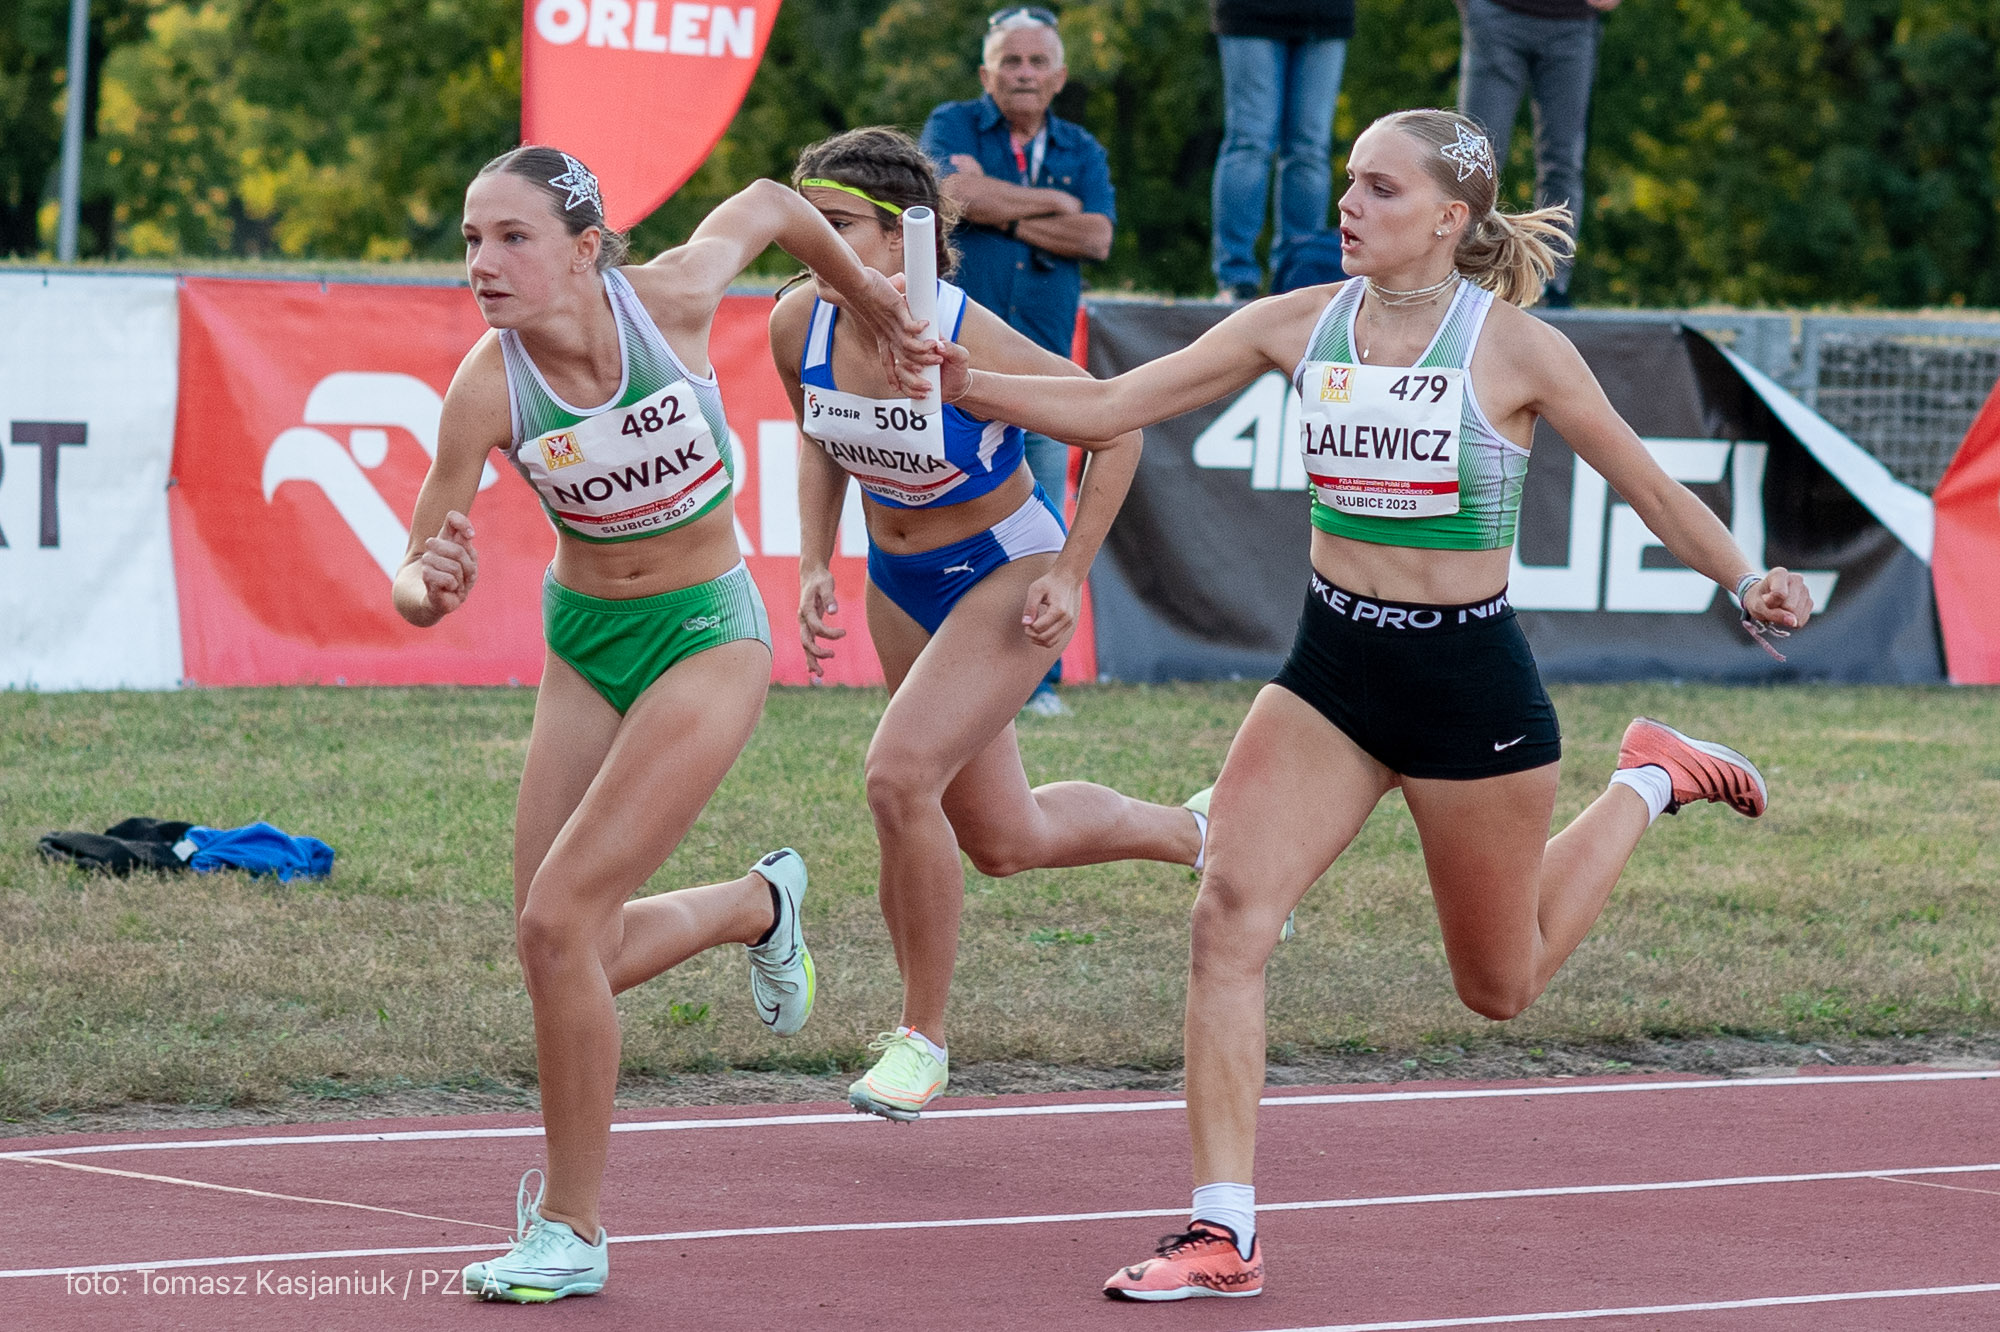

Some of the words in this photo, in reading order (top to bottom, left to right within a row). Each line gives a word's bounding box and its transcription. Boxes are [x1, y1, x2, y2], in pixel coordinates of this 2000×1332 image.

[534, 0, 756, 59] ORLEN
[1321, 390, 1349, 401] PZLA
[1389, 374, 1448, 403] 479
[621, 395, 687, 438] 482
[874, 406, 928, 431] 508
[1305, 422, 1452, 462] LALEWICZ
[0, 421, 88, 549] T
[552, 439, 704, 505] NOWAK
[601, 517, 662, 534] SŁUBICE
[663, 497, 696, 521] 2023
[1336, 495, 1383, 508] SŁUBICE
[1386, 498, 1417, 510] 2023
[1312, 572, 1351, 615] KE
[1352, 601, 1442, 630] PRO
